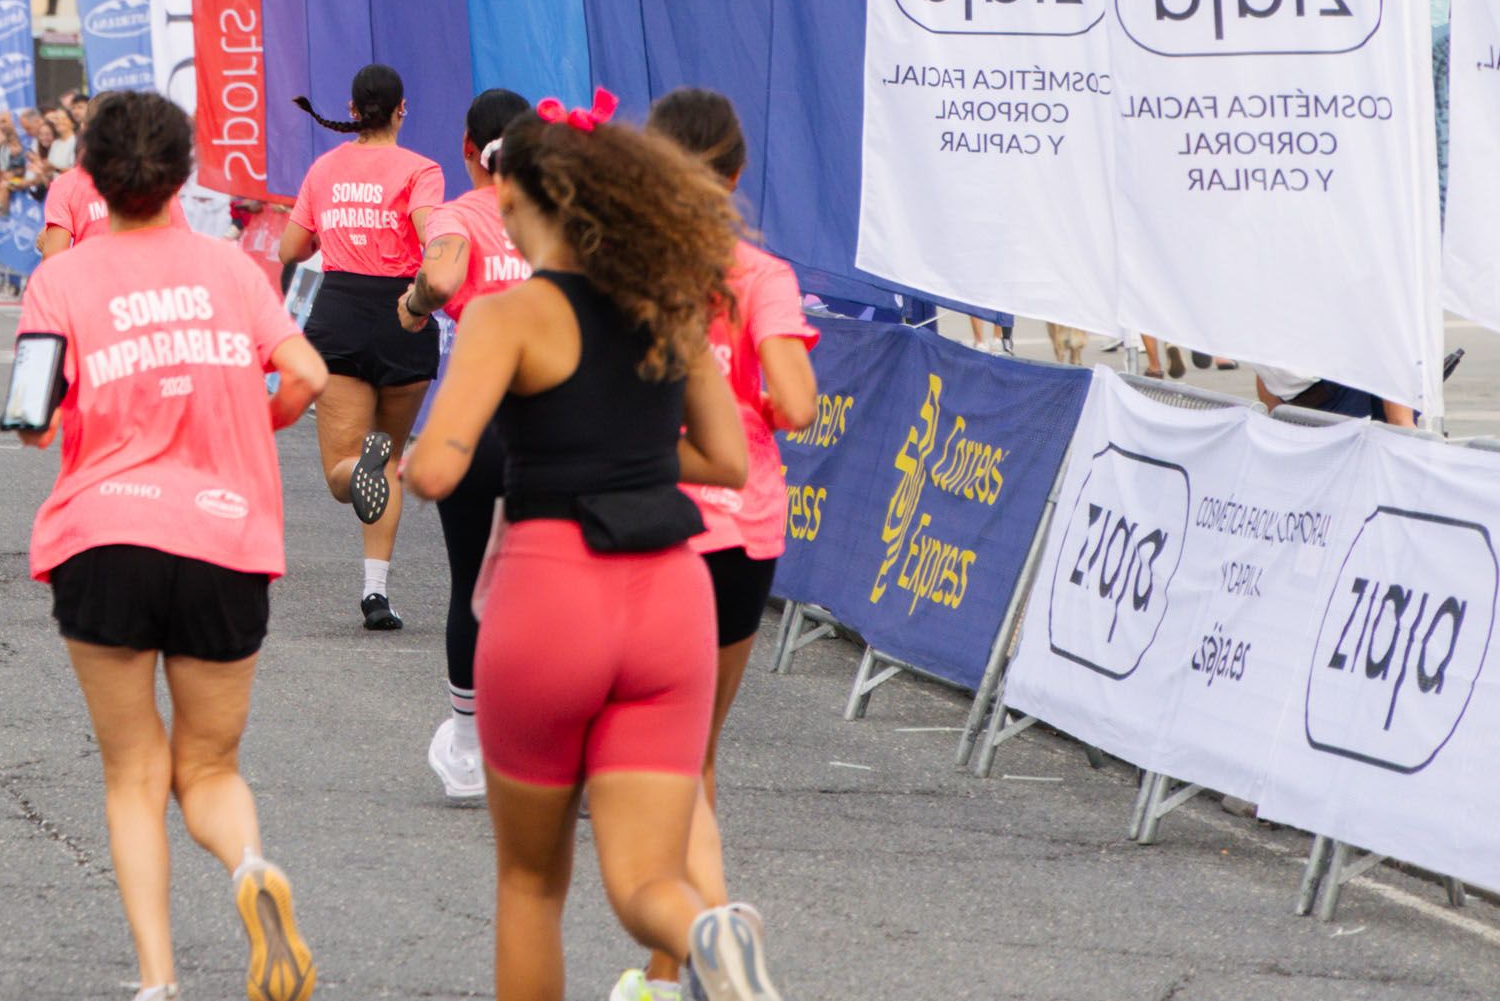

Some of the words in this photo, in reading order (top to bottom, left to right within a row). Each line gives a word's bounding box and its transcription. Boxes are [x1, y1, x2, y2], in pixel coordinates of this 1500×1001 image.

[332, 183, 383, 204] SOMOS
[109, 285, 213, 331] SOMOS
[86, 329, 252, 388] IMPARABLES
[100, 481, 160, 499] OYSHO
[1070, 503, 1168, 643] ziaja
[1328, 577, 1467, 731] ziaja
